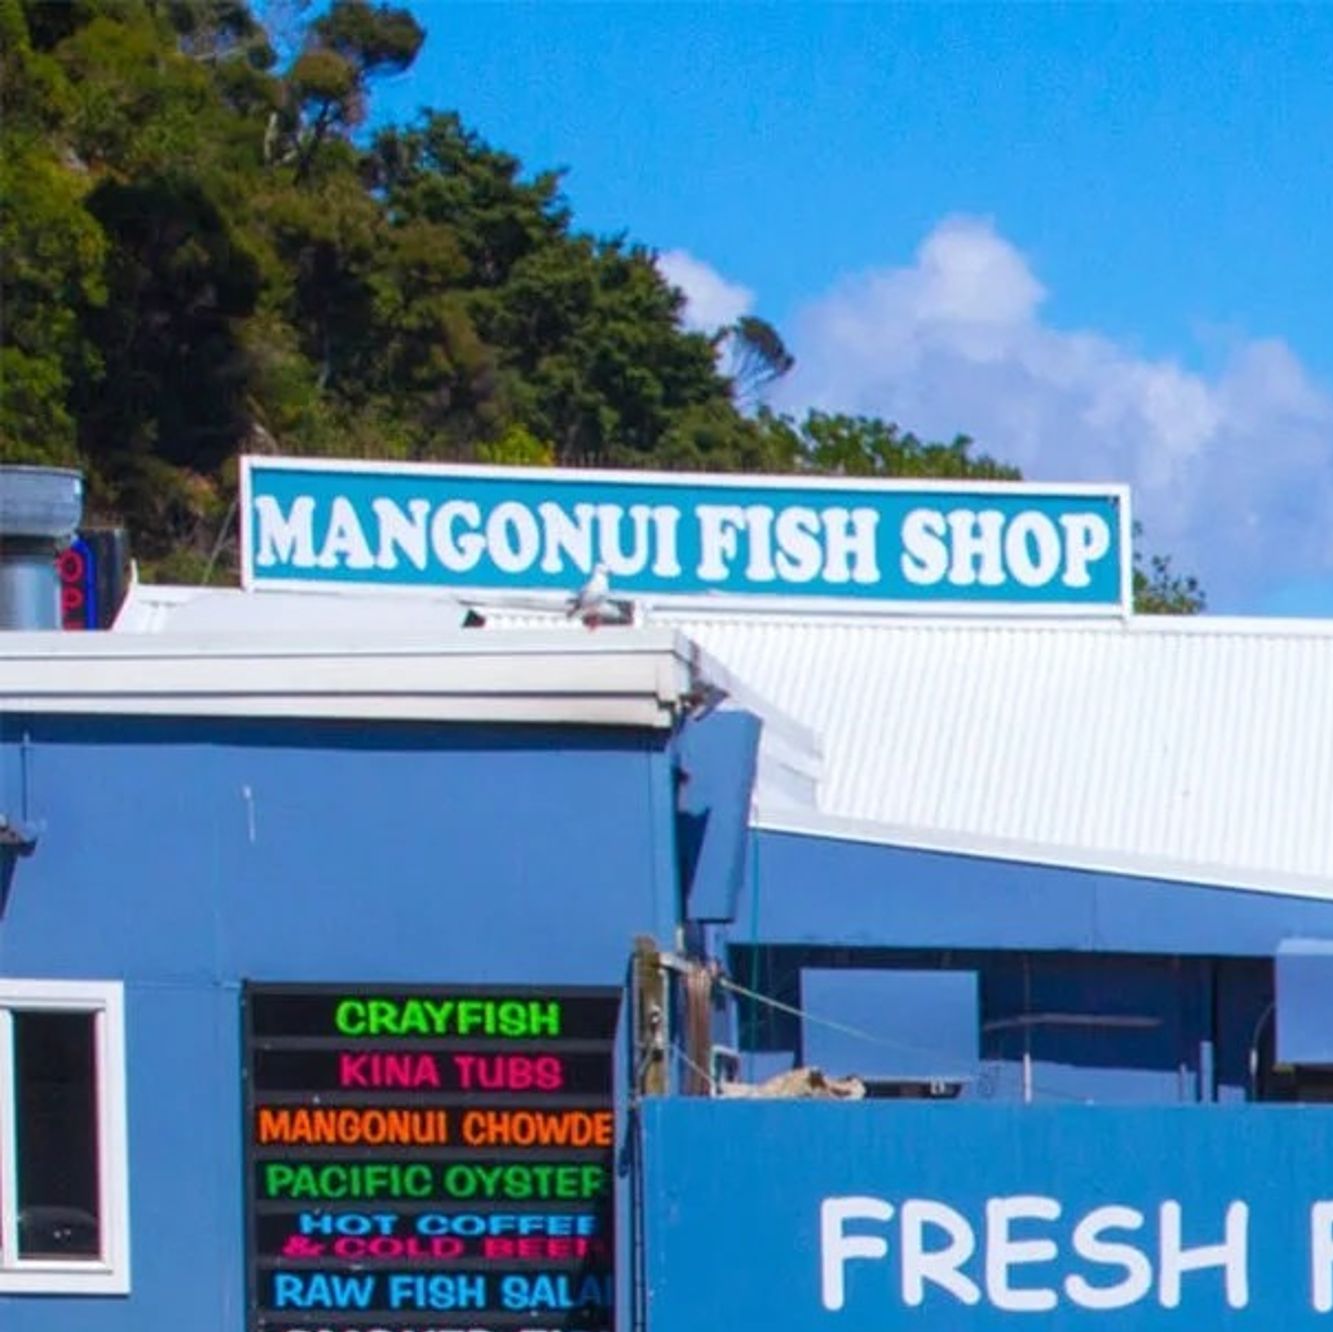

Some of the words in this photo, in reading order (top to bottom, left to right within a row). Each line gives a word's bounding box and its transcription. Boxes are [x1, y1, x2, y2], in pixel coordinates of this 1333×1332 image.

[254, 495, 681, 578] MANGONUI
[696, 505, 881, 584] FISH
[900, 509, 1109, 588] SHOP
[335, 999, 561, 1036] CRAYFISH
[340, 1054, 441, 1088] KINA
[454, 1055, 563, 1091] TUBS
[259, 1109, 448, 1144] MANGONUI
[265, 1163, 433, 1198] PACIFIC
[299, 1213, 397, 1236] HOT
[282, 1235, 326, 1259] &
[333, 1236, 464, 1259] COLD
[820, 1195, 1250, 1312] FRESH
[274, 1273, 376, 1308] RAW
[388, 1275, 486, 1309] FISH
